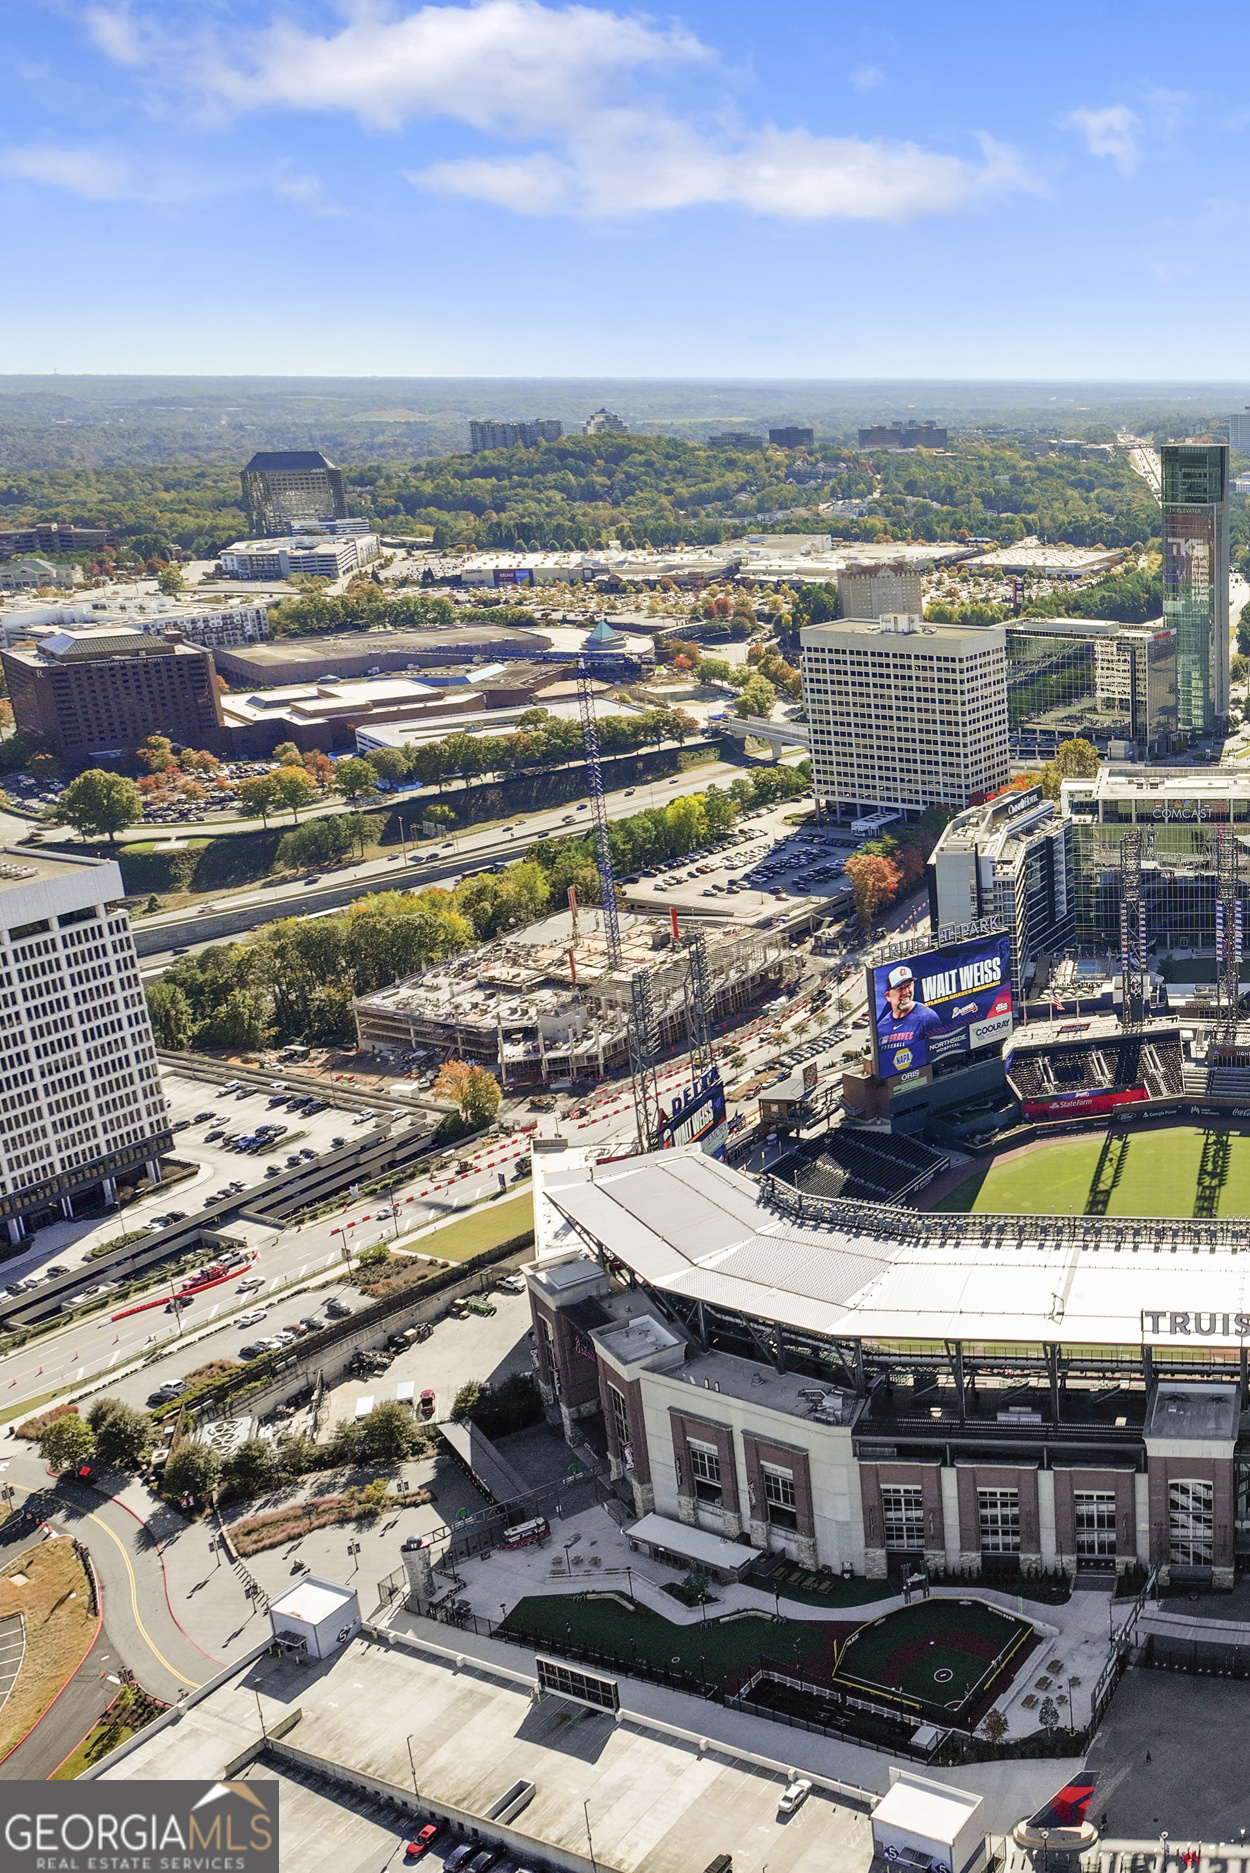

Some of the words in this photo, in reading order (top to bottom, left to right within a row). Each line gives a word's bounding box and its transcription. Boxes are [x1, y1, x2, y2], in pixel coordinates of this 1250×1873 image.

[90, 660, 124, 668] RENAISSANCE
[124, 658, 147, 666] WAVERLY
[147, 656, 164, 664] HOTEL
[35, 669, 45, 679] R
[1152, 808, 1214, 819] COMCAST
[879, 932, 935, 959] TRUIST
[960, 914, 1000, 938] PARK
[921, 969, 958, 1003] WALT
[958, 956, 1002, 991] WEISS
[975, 1018, 1011, 1037] COOLRAY
[928, 1033, 968, 1051] NORTHSIDE
[936, 1042, 961, 1053] HOSPITAL
[895, 1053, 912, 1066] NAPA
[901, 1069, 920, 1081] ORIS
[671, 1066, 720, 1116] DELTA
[339, 1630, 347, 1642] 5
[888, 1846, 897, 1859] 5
